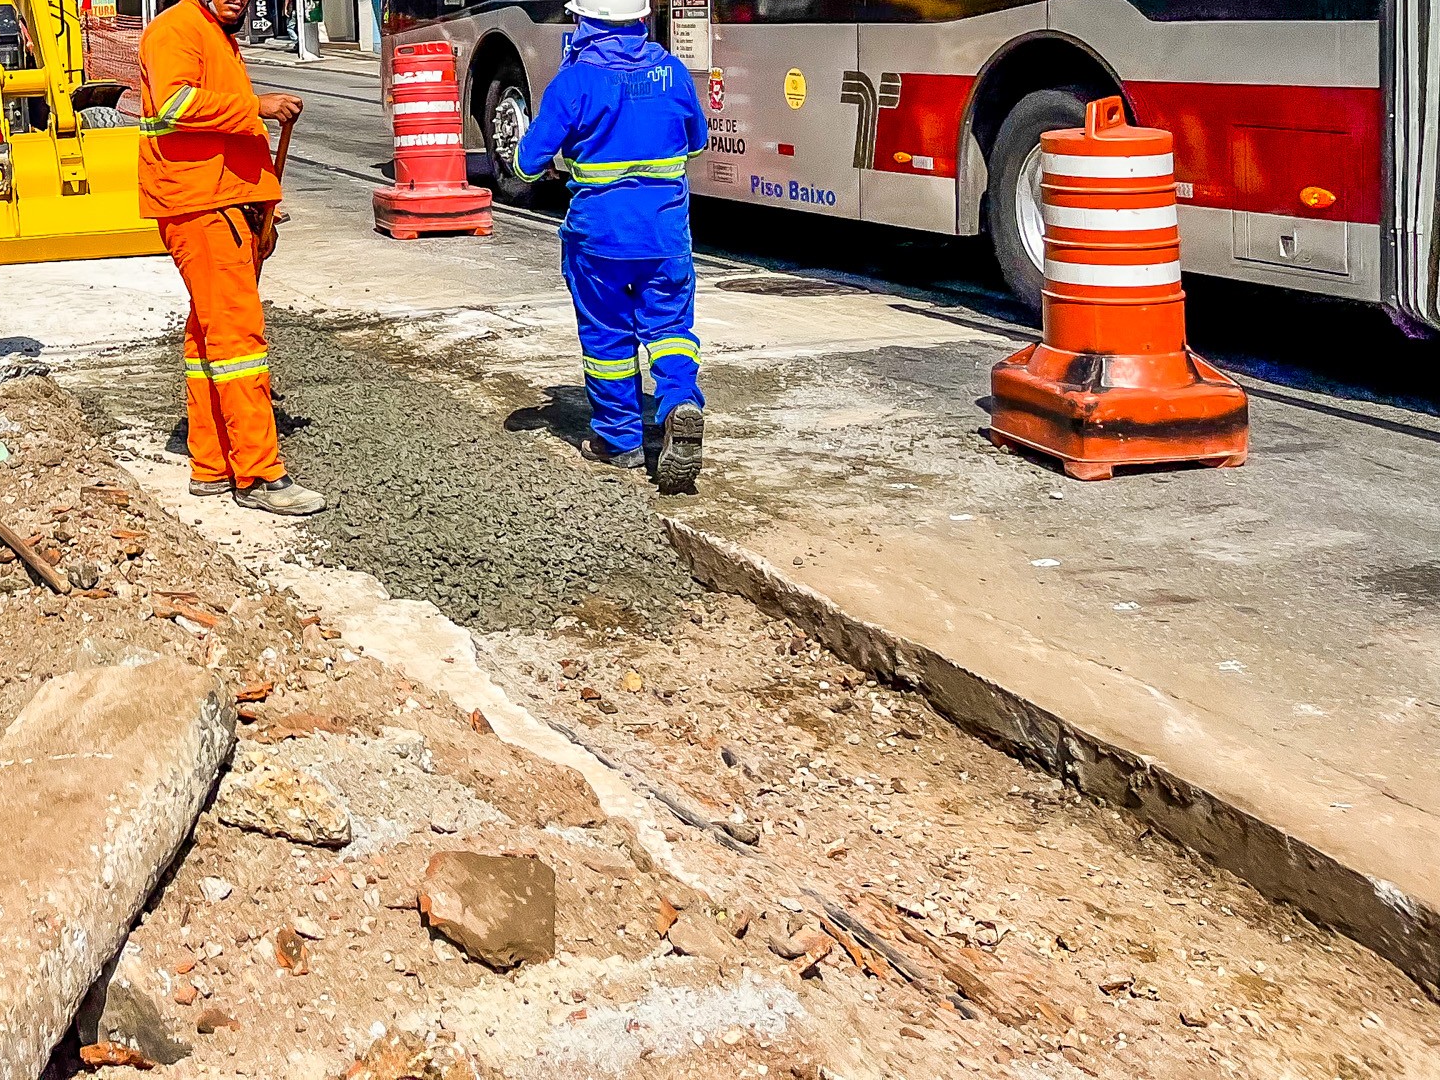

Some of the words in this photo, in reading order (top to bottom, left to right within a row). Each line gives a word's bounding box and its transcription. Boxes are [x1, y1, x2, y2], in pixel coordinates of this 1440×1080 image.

[707, 117, 723, 132] ADE
[726, 119, 738, 133] DE
[711, 136, 746, 155] PAULO
[750, 174, 784, 198] Piso
[788, 180, 836, 206] Baixo
